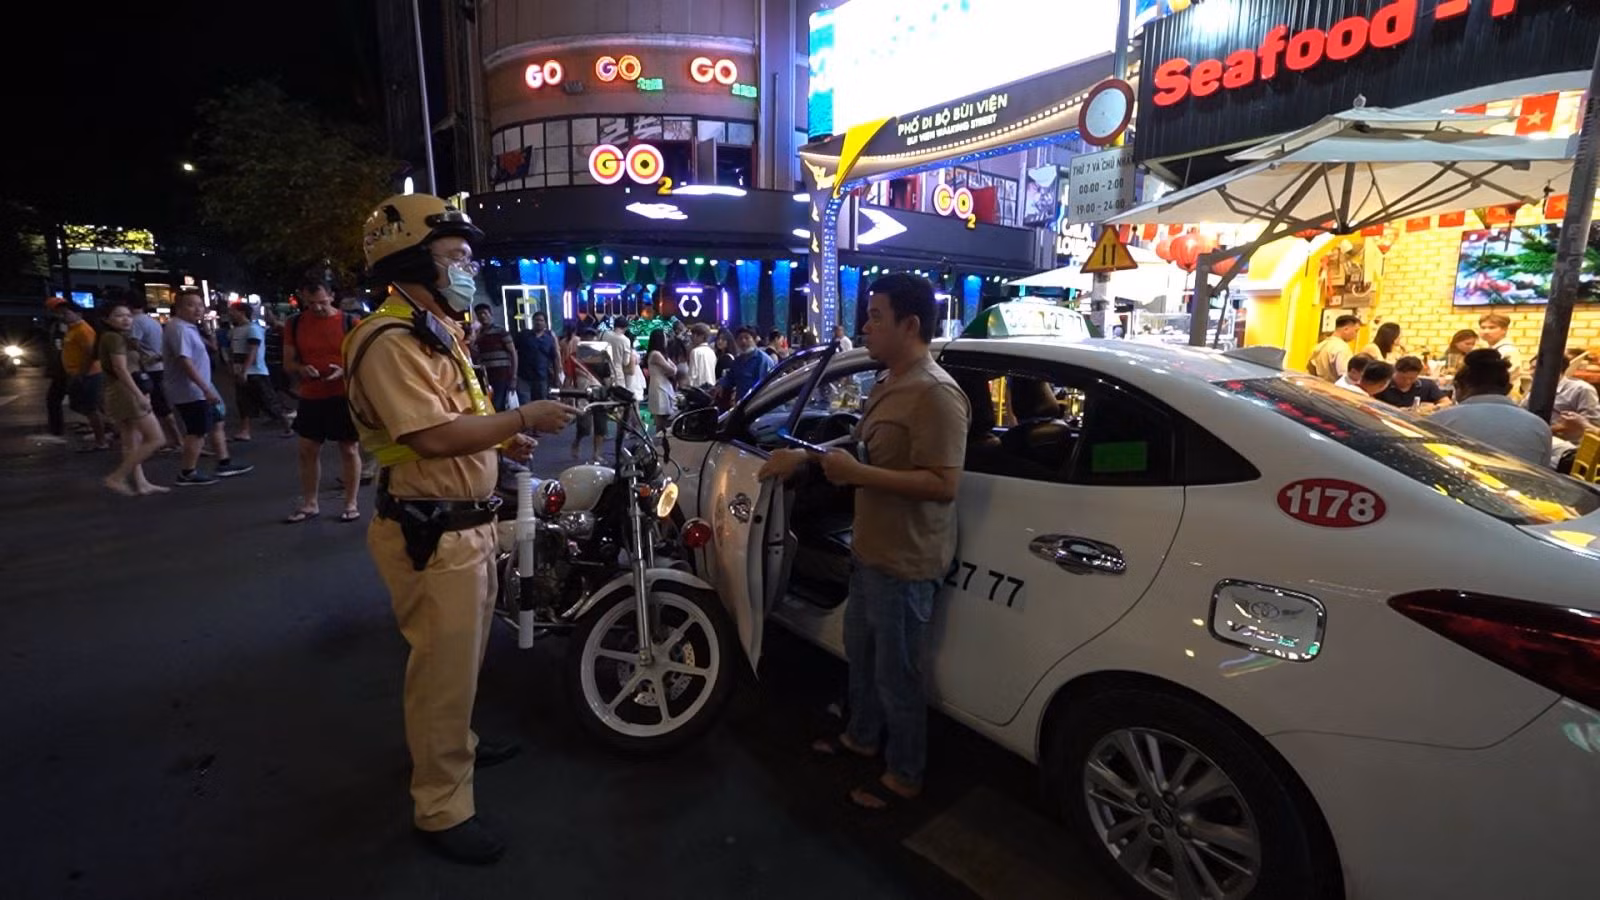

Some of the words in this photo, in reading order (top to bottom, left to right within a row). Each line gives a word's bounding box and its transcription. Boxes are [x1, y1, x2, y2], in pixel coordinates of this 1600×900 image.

[595, 55, 641, 82] GO
[690, 57, 737, 85] GO
[1153, 0, 1417, 106] Seafood
[525, 59, 563, 89] GO
[898, 115, 920, 136] PHỐ
[922, 116, 932, 130] DI
[934, 107, 950, 126] BỘ
[976, 93, 1008, 114] VIỆN
[588, 144, 664, 185] GO
[656, 177, 673, 195] 2
[1086, 164, 1091, 174] 7
[933, 184, 973, 219] GO
[967, 213, 976, 229] 2
[1286, 484, 1376, 523] 1178
[988, 569, 1025, 608] 77
